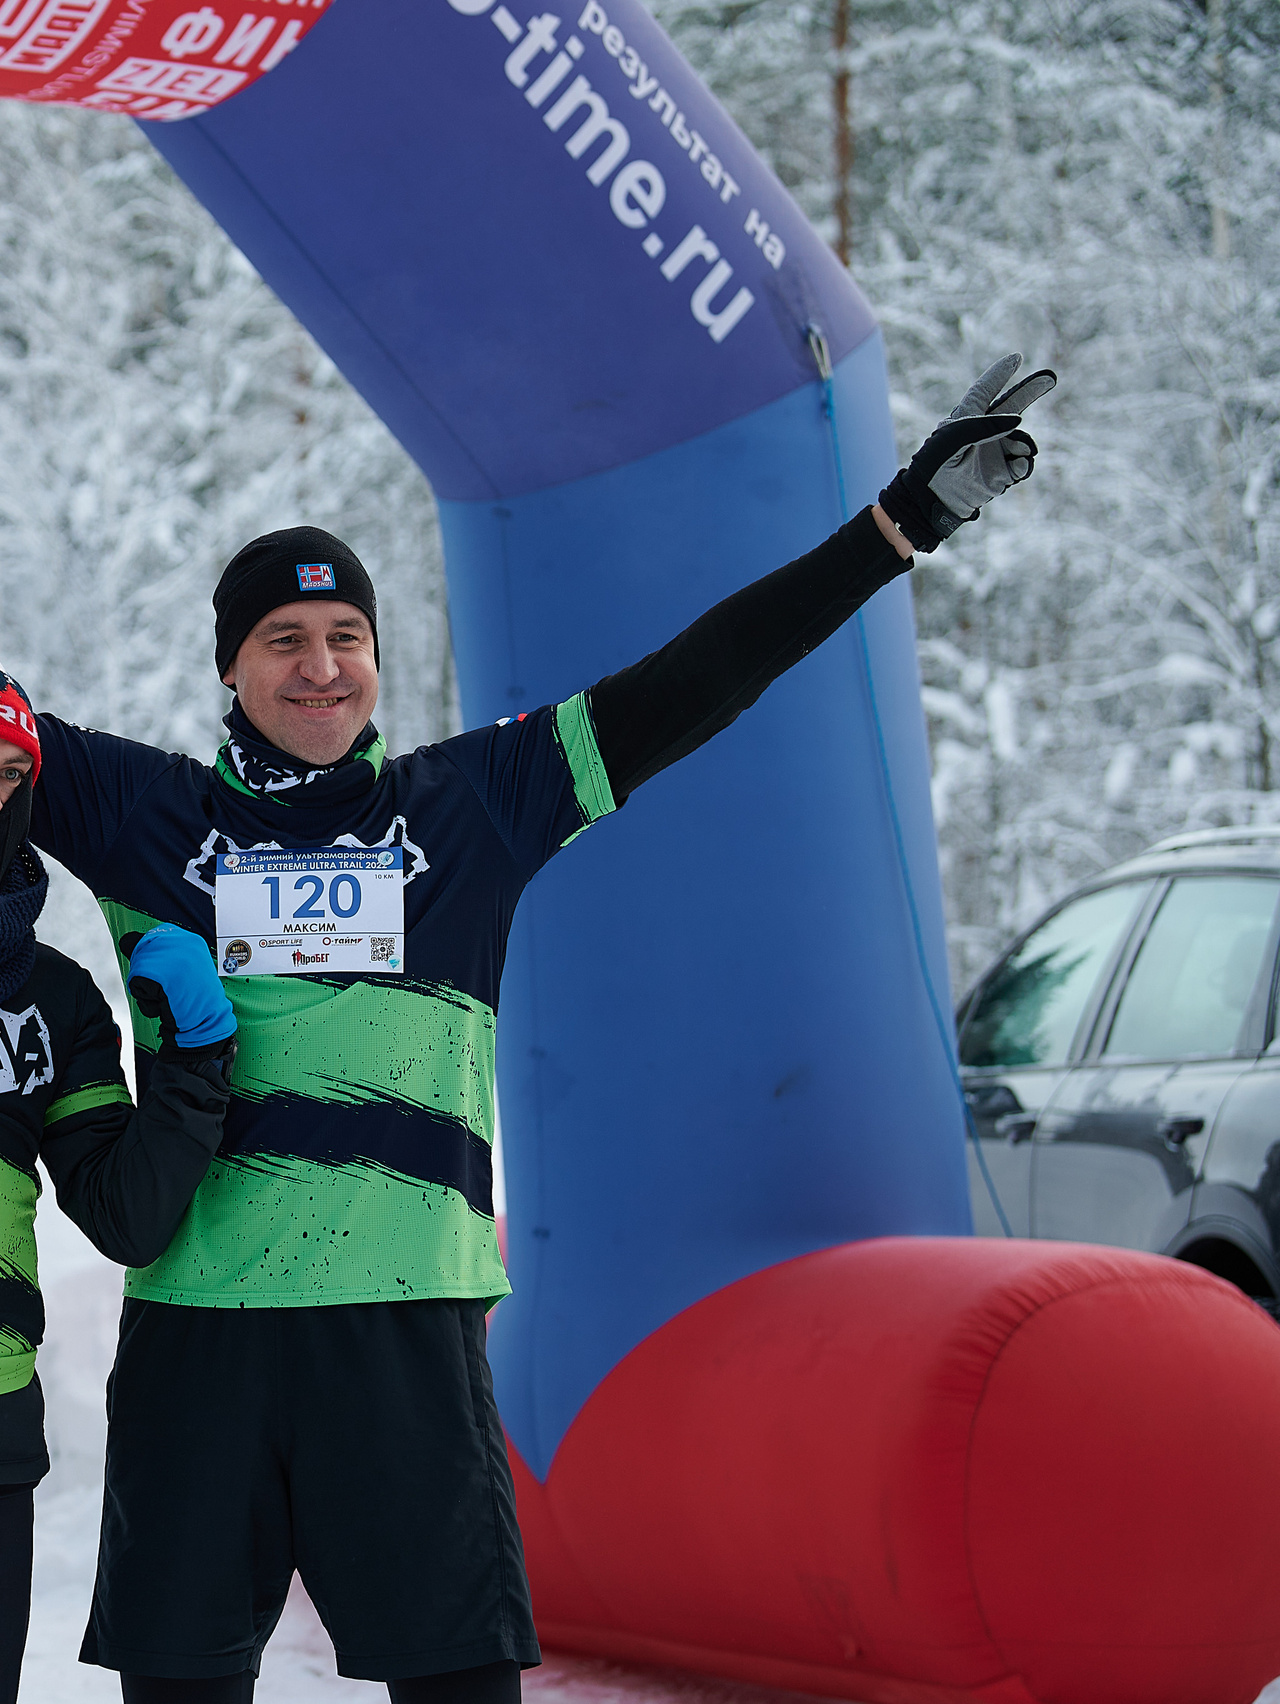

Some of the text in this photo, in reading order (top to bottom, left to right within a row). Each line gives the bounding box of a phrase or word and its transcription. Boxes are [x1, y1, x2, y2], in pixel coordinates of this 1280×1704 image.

[578, 0, 786, 270] результат на
[259, 852, 293, 862] зимний
[296, 851, 378, 861] ультрамарафон
[232, 864, 265, 873] WINTER
[267, 862, 307, 871] EXTREME
[309, 861, 336, 870] ULTRA
[338, 861, 363, 869] TRAIL
[261, 874, 362, 919] 120
[283, 923, 336, 933] МАКСИМ
